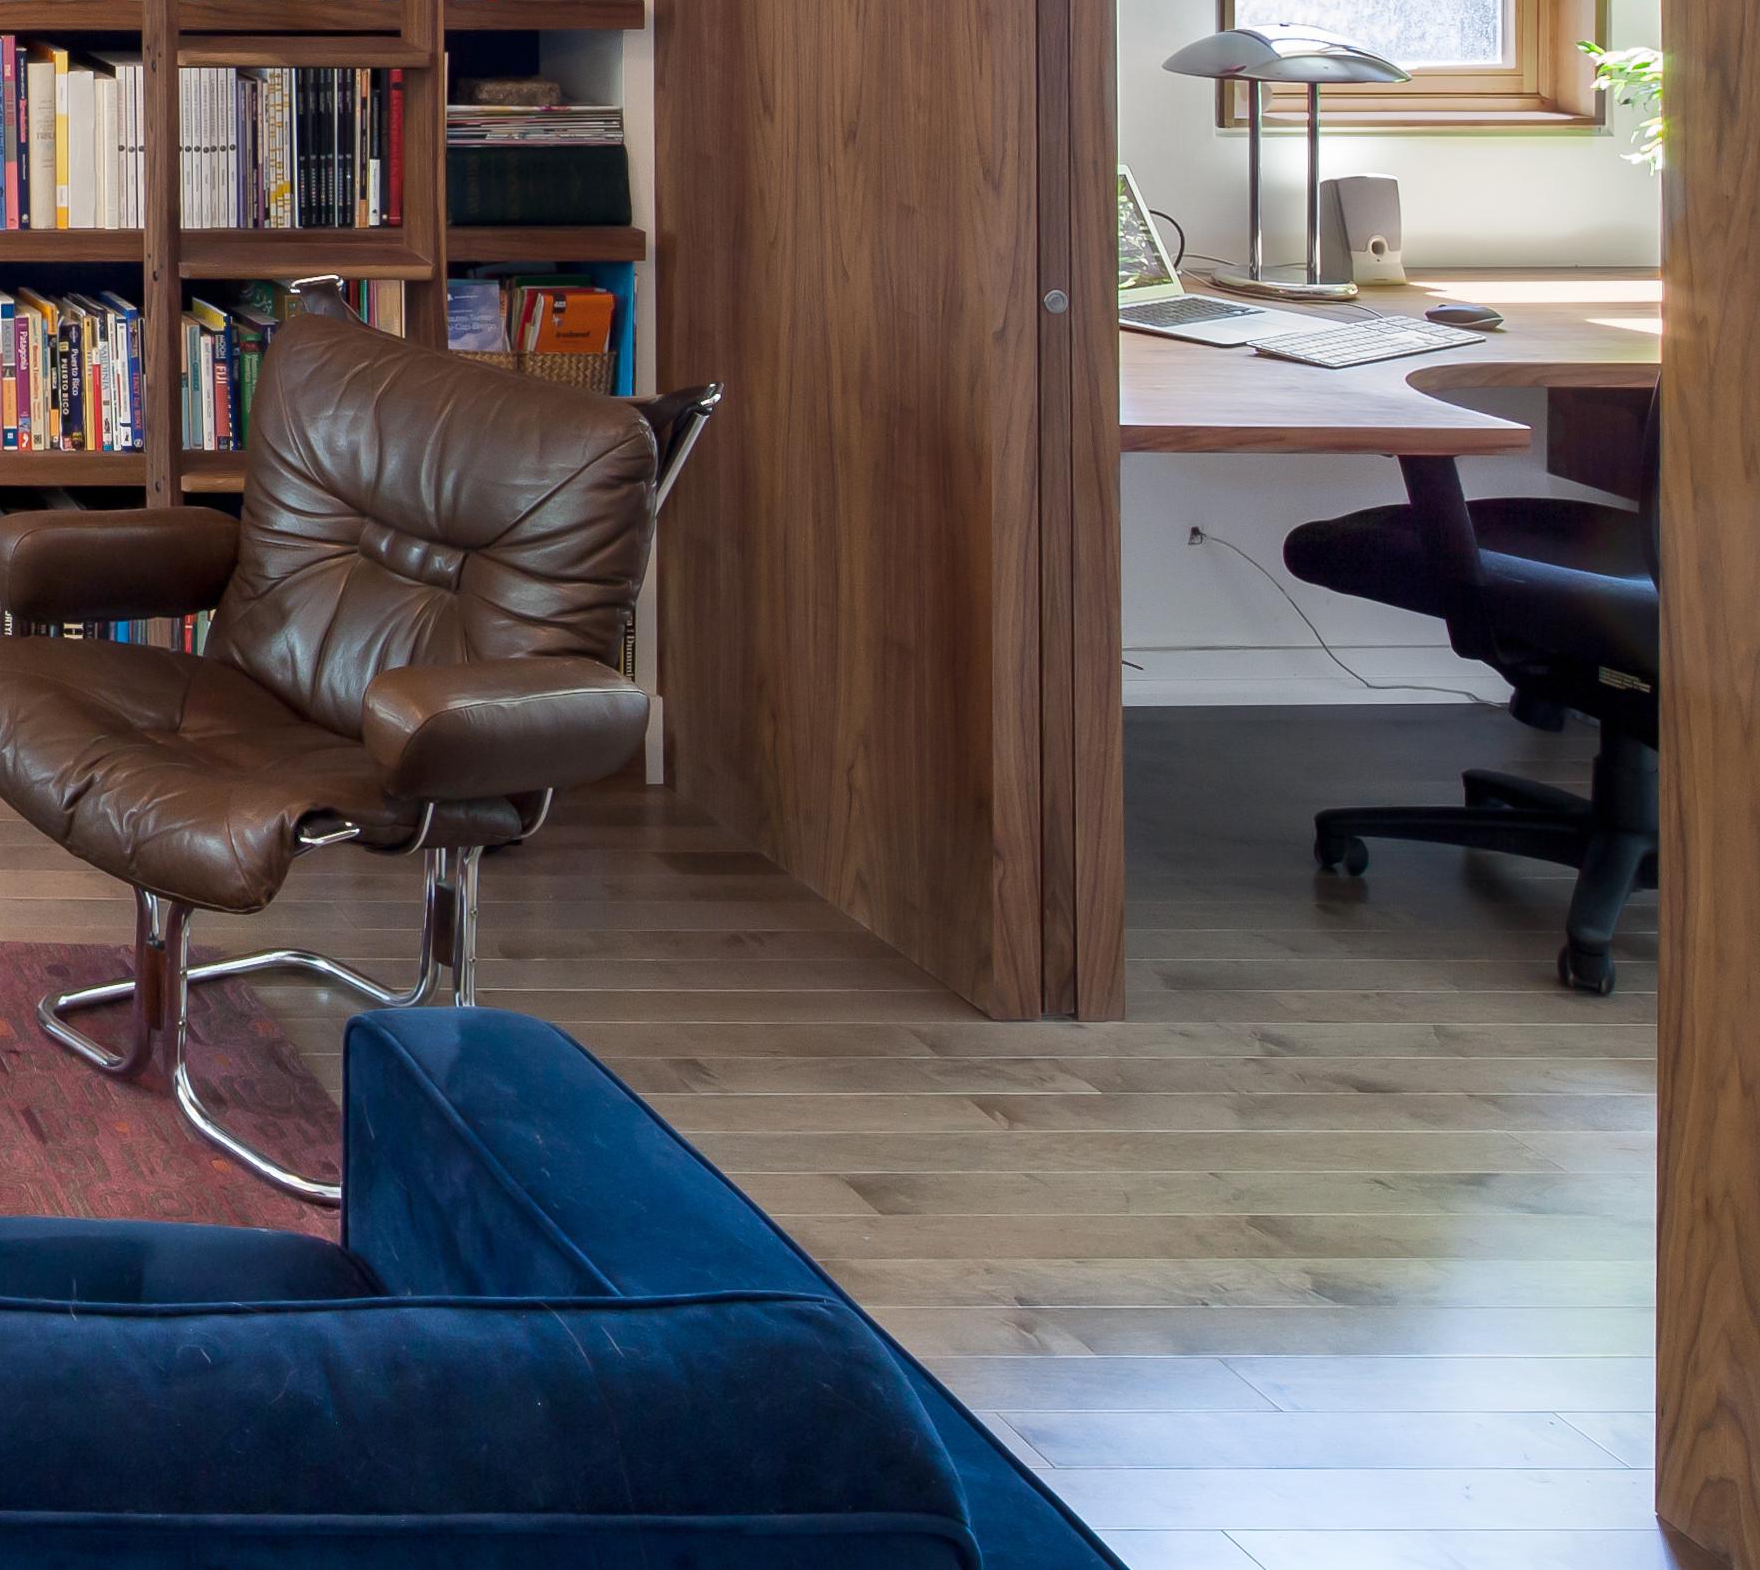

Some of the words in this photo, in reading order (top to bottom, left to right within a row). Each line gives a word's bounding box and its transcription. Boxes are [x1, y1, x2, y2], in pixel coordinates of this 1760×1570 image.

[18, 331, 28, 370] Patagonia
[71, 348, 80, 378] Puerto
[215, 365, 226, 384] FIJI
[71, 381, 80, 396] Rico
